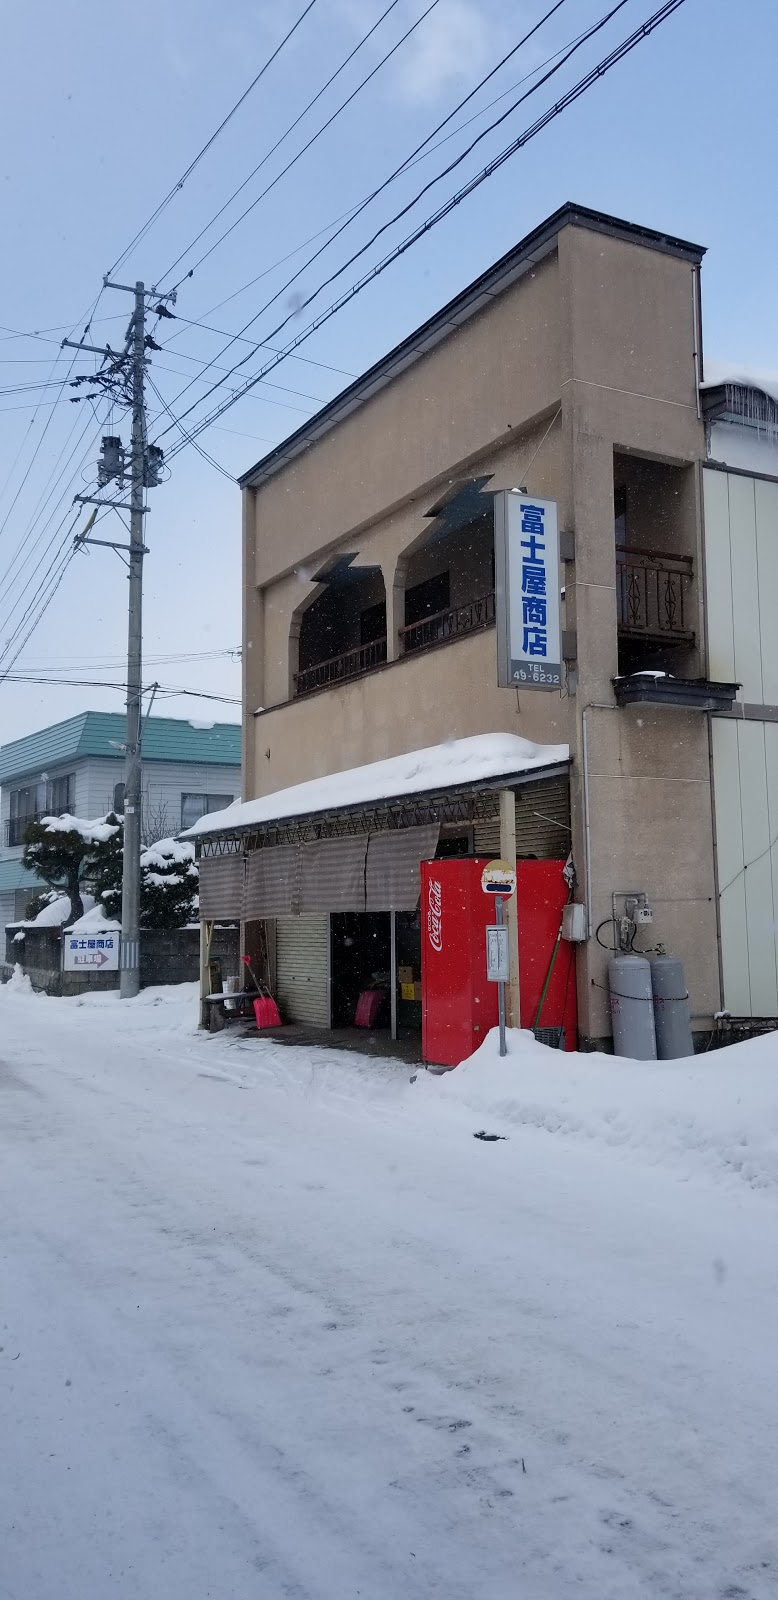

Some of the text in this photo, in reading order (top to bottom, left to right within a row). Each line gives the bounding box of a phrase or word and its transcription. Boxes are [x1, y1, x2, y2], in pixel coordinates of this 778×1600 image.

[519, 504, 548, 657] 富士屋商店
[527, 663, 545, 673] TEL
[513, 670, 560, 683] 49-6232
[69, 939, 114, 950] 富士屋商店
